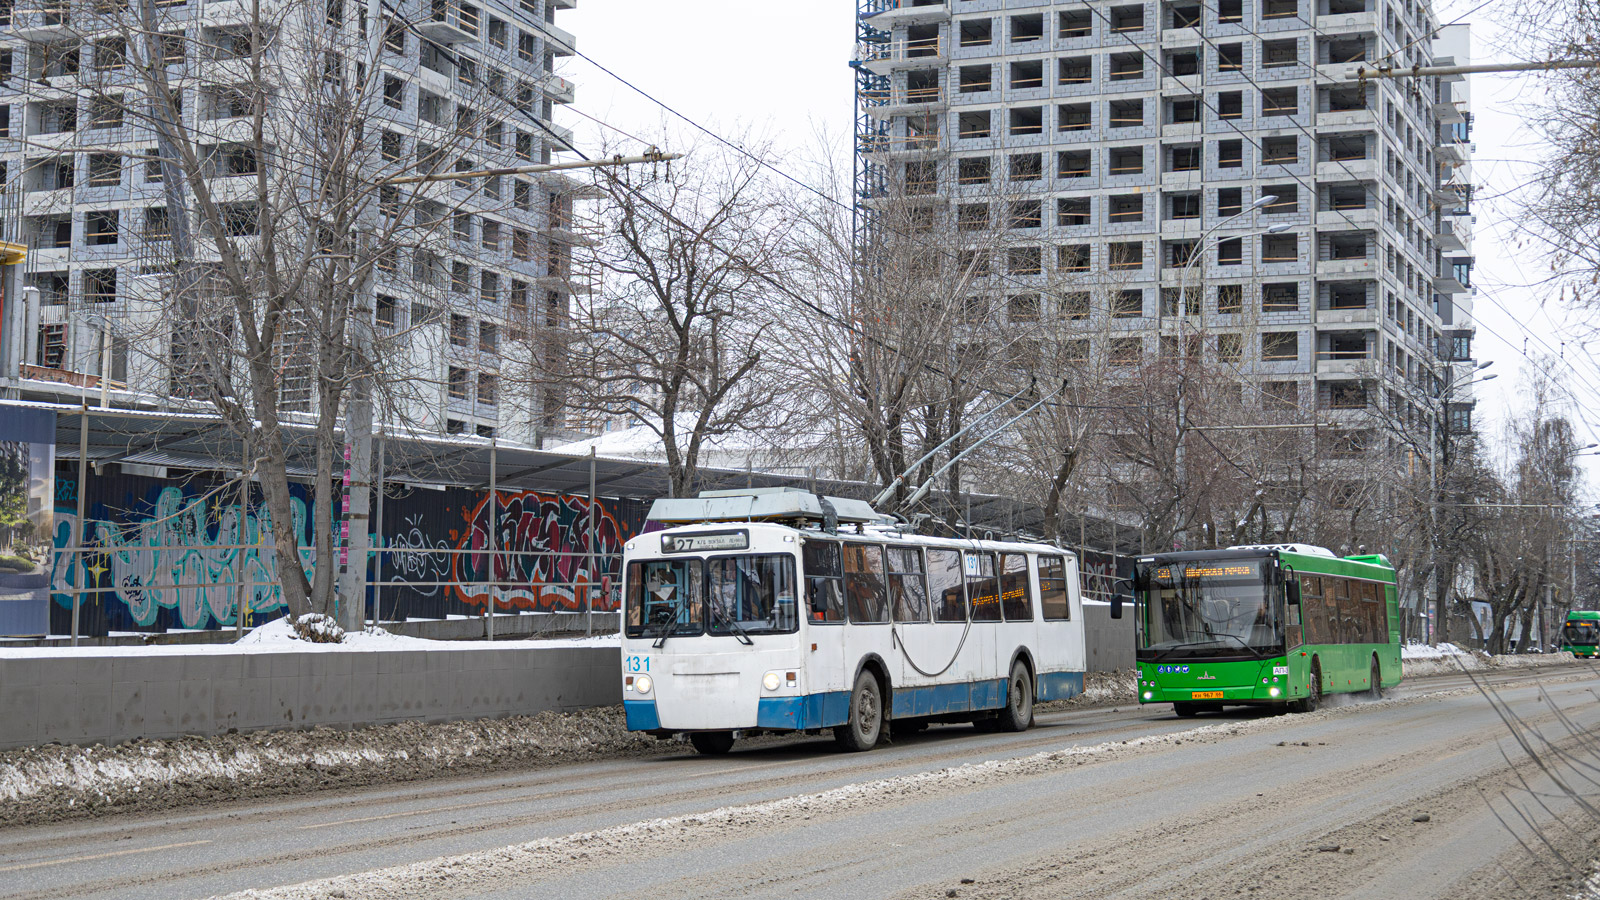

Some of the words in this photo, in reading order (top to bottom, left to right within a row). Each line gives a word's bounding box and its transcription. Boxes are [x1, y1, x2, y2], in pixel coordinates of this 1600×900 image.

[677, 539, 694, 551] 27
[967, 556, 977, 569] 131
[626, 656, 650, 672] 131
